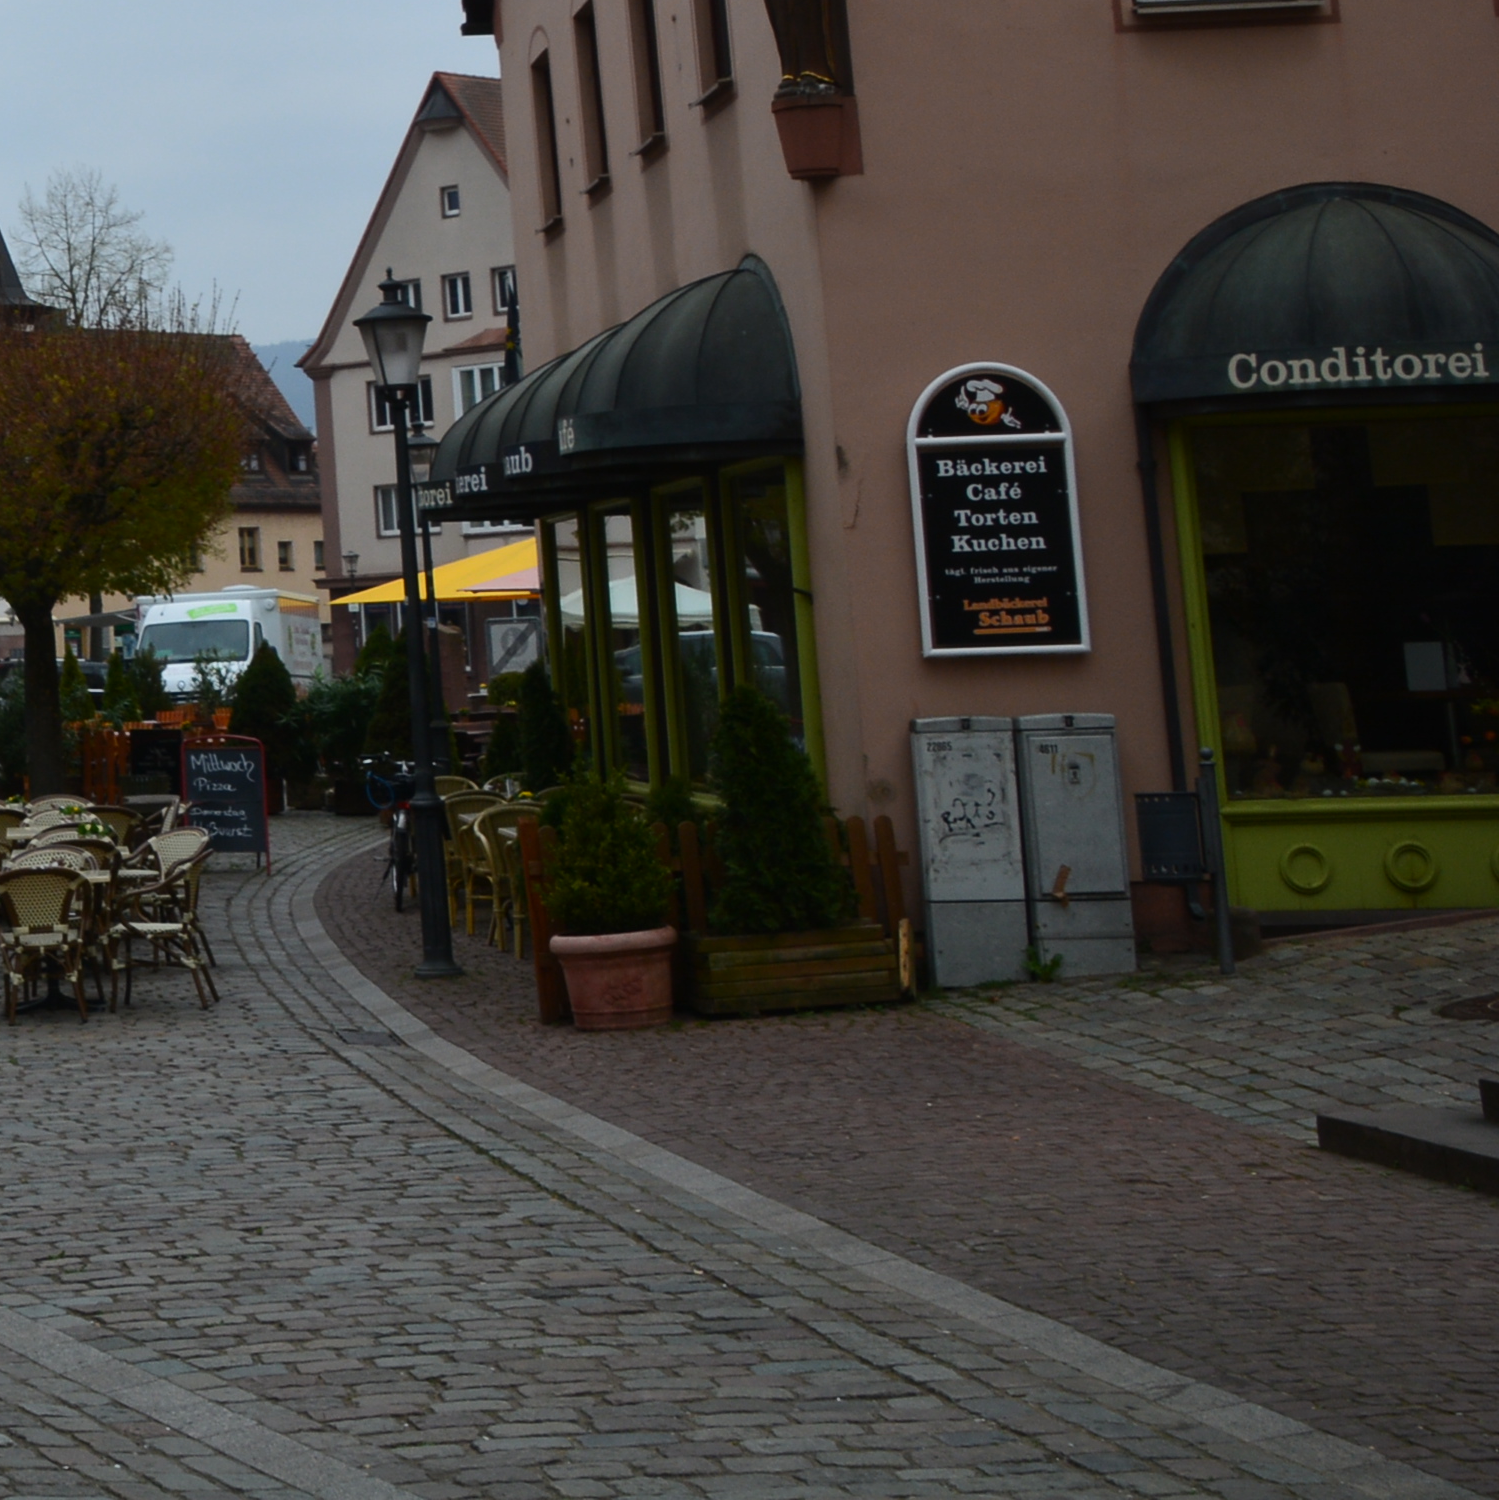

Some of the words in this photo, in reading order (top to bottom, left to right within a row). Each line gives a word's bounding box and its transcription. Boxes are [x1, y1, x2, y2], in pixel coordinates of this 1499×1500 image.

[1228, 342, 1490, 389] Conditorei
[558, 418, 575, 451] fé
[936, 456, 1048, 477] Bäckerei
[966, 482, 1022, 501] Café
[953, 508, 1040, 526] Torten
[950, 533, 1047, 553] Kuchen
[945, 567, 967, 577] tägl.
[970, 566, 999, 575] frisch
[1022, 565, 1058, 574] eigener
[973, 575, 1031, 584] Herstellung
[962, 597, 1049, 611] Landbäckerei
[978, 609, 1050, 627] Schaub
[190, 753, 255, 783] Mittwoch
[193, 777, 237, 791] Pizza
